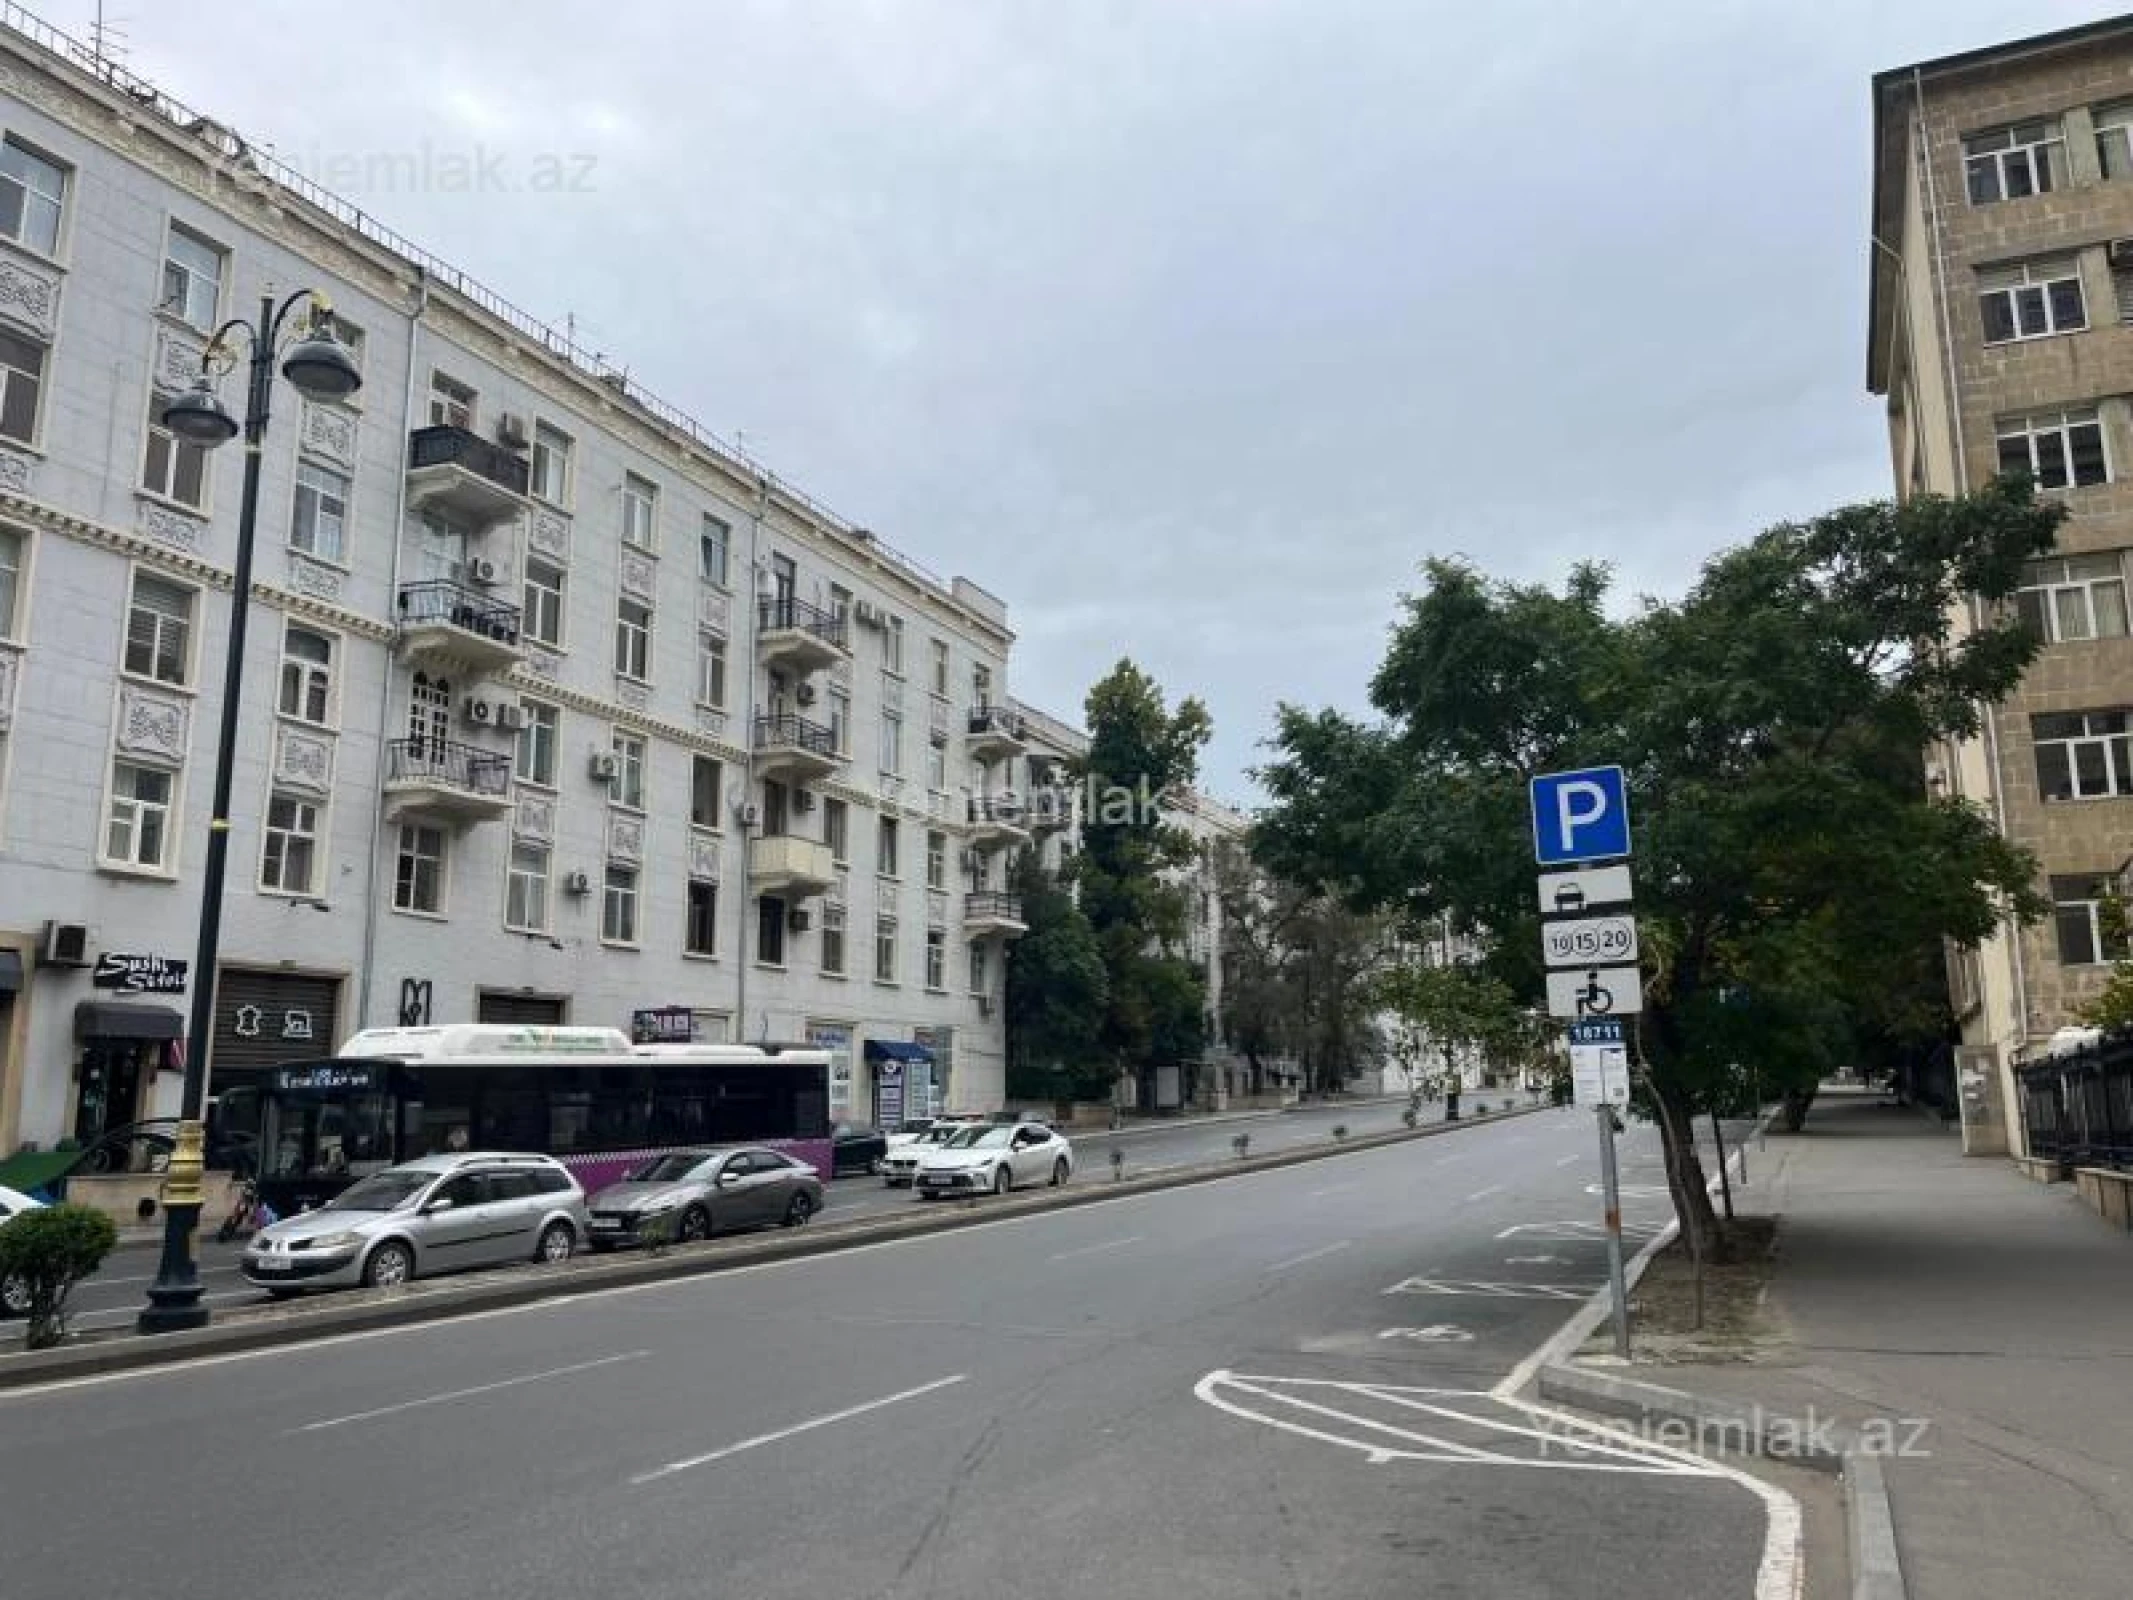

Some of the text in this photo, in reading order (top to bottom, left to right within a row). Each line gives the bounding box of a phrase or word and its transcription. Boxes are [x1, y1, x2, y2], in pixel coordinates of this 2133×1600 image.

[1557, 781, 1607, 851] P
[1551, 930, 1628, 950] 10 15 20
